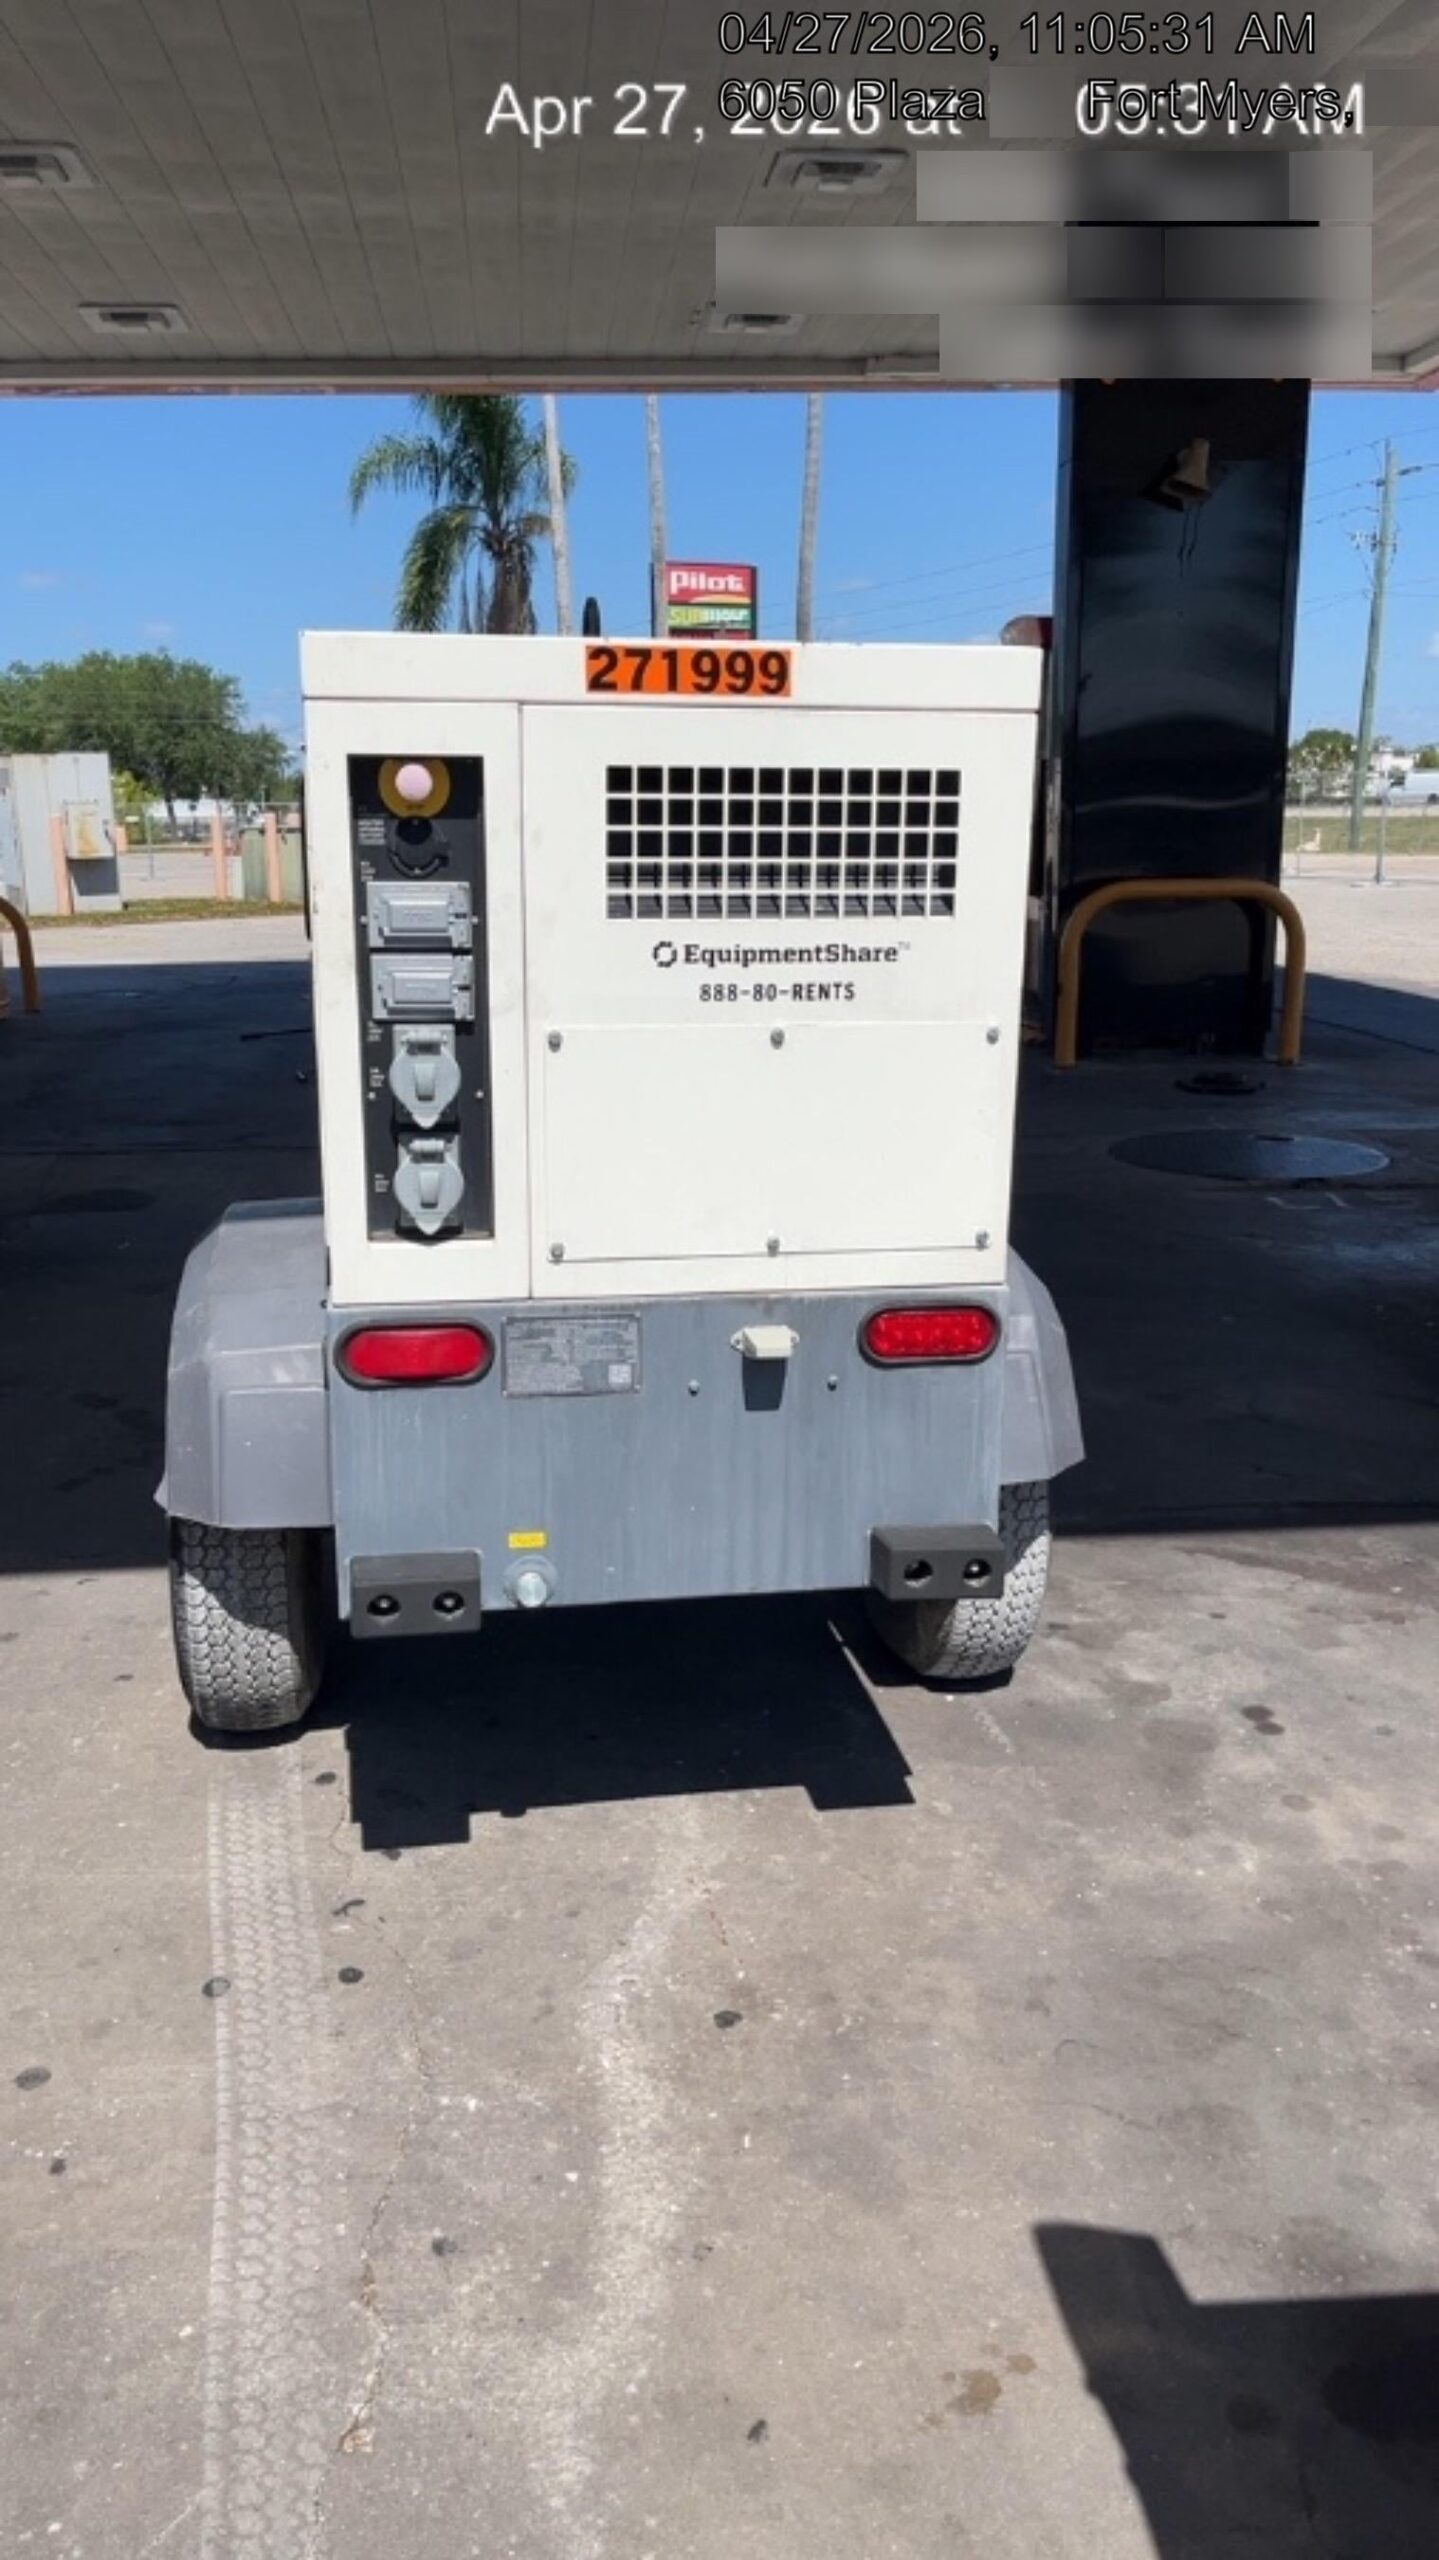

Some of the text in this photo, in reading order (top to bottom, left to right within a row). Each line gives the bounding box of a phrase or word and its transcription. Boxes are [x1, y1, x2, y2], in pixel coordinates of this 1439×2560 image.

[671, 571, 745, 595] Pilot
[587, 646, 789, 694] 271999
[683, 943, 899, 967] EquipmentShare
[700, 982, 856, 1002] 888-80-RENTS
